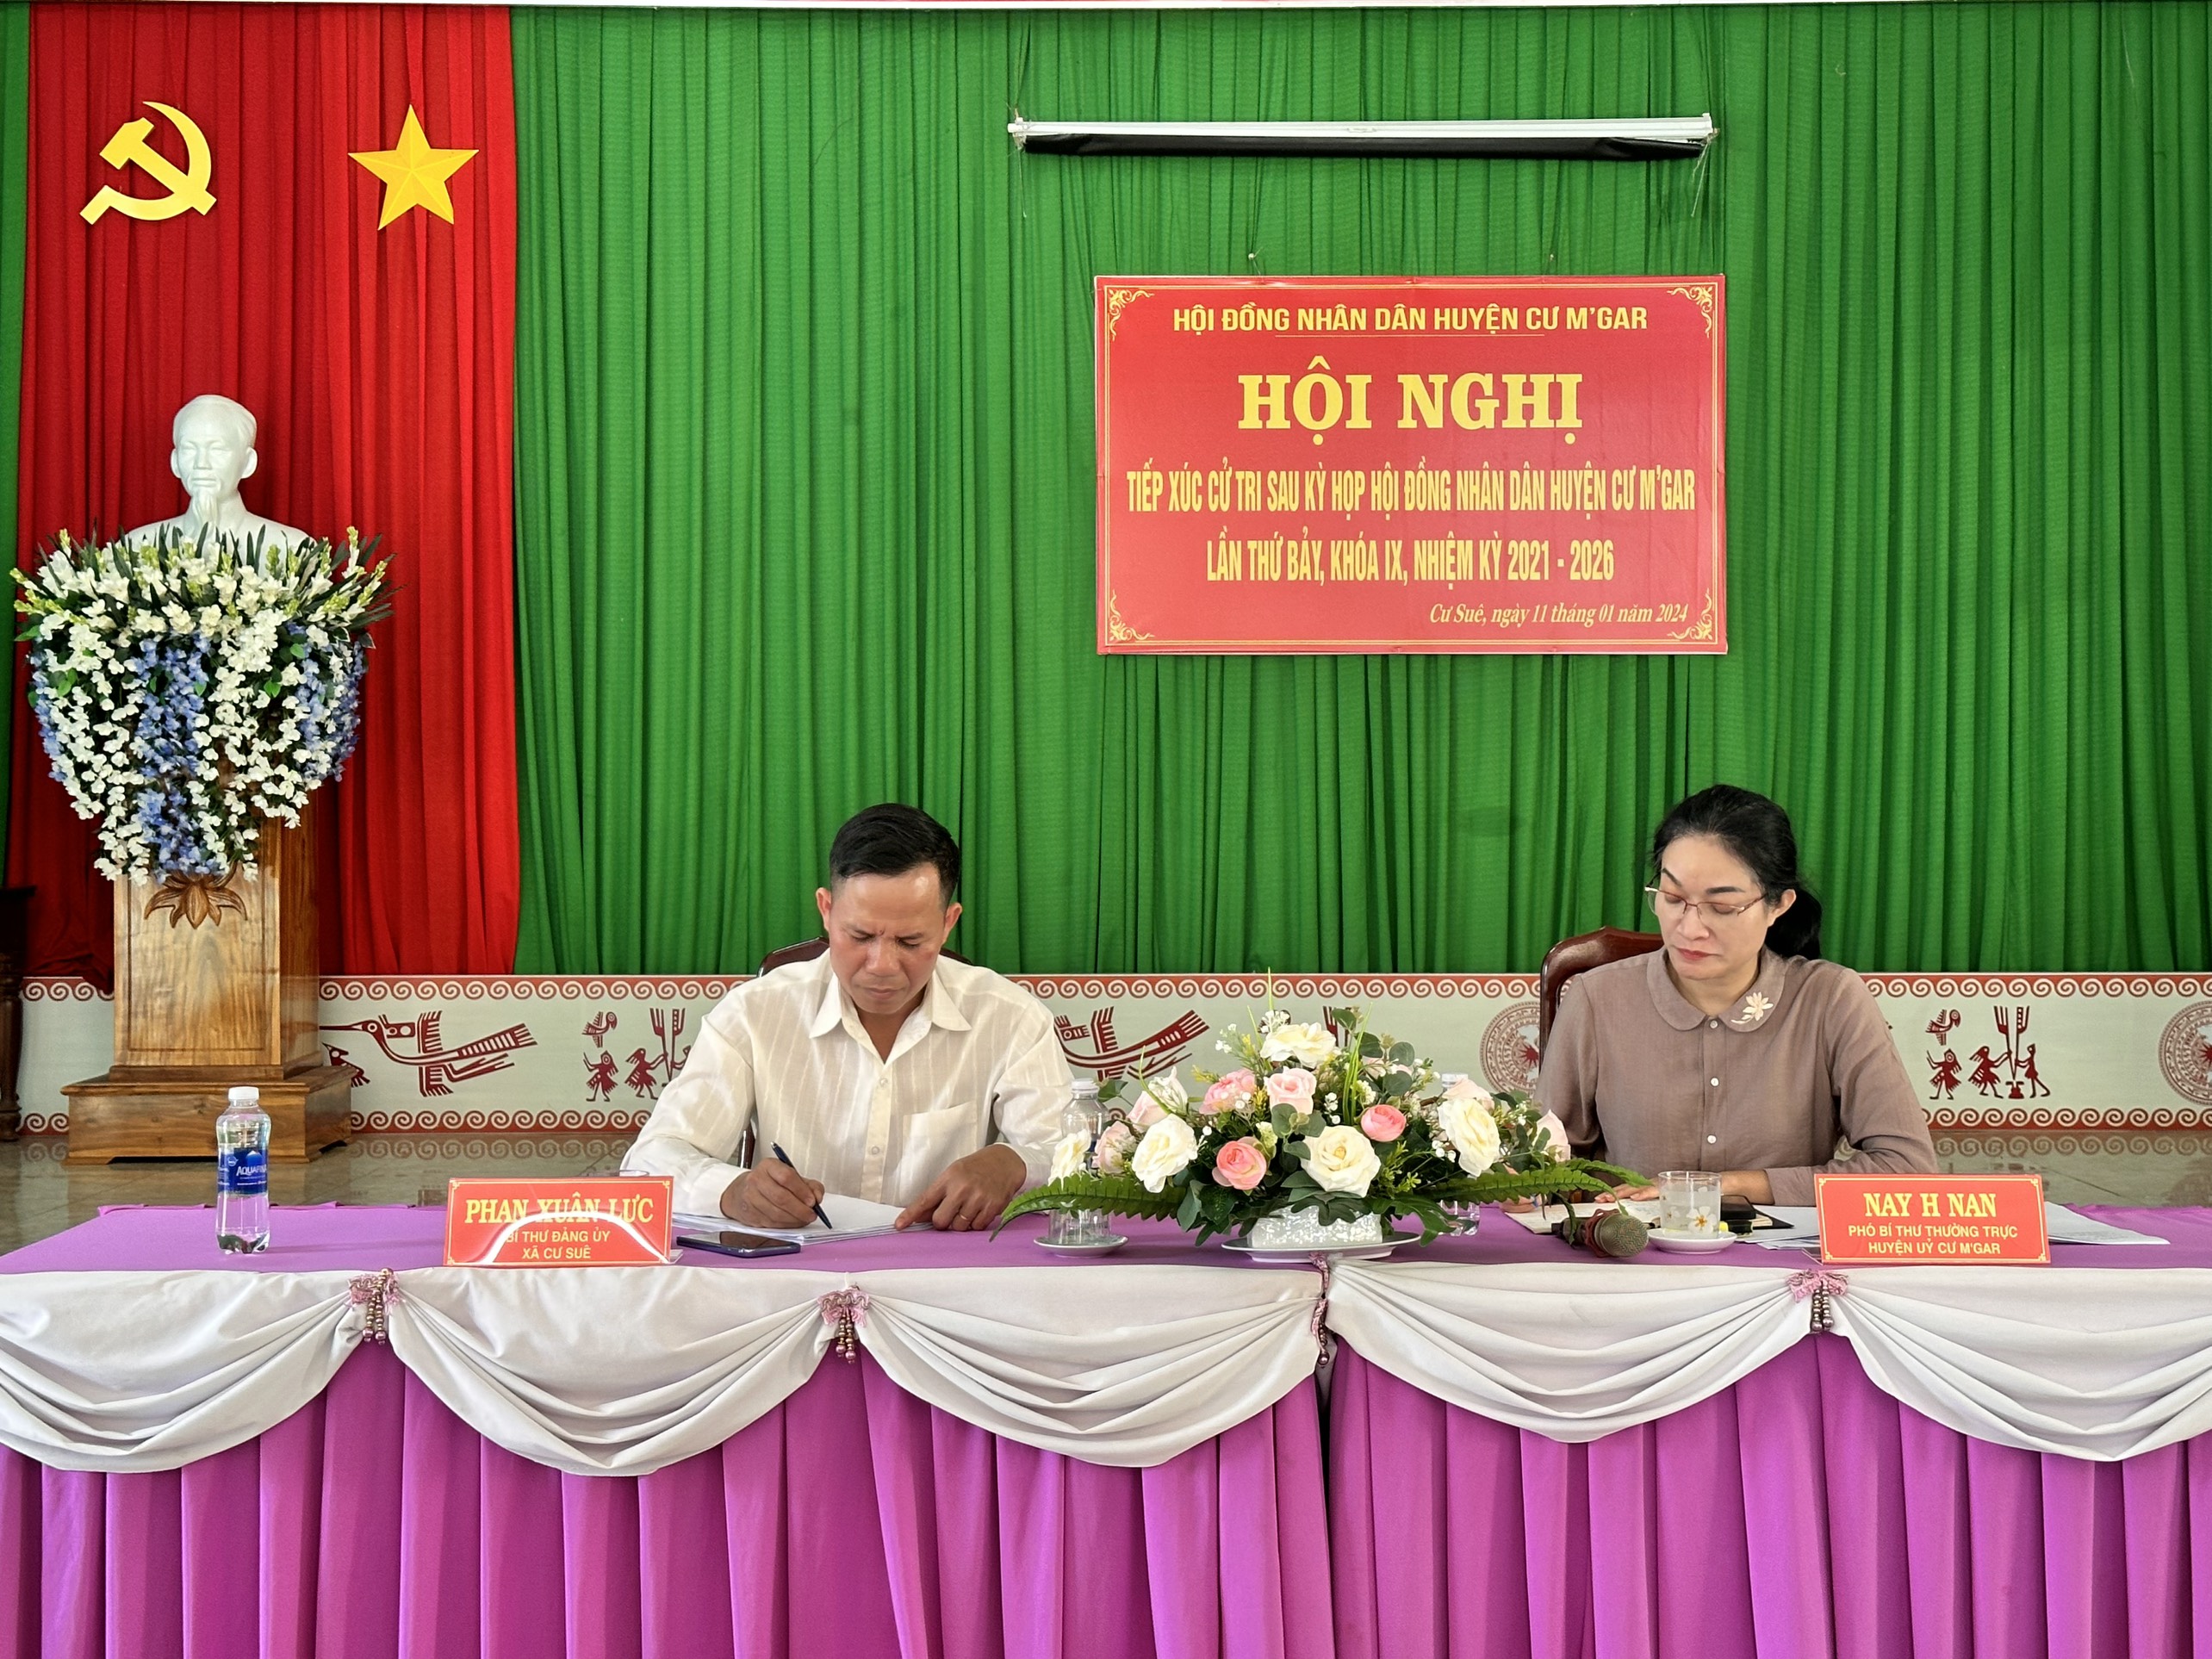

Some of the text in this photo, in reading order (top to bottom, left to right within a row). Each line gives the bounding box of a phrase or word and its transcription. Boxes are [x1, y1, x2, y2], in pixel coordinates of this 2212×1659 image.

[1173, 304, 1215, 332] HỘI
[1221, 301, 1289, 331] ĐỒNG
[1298, 303, 1367, 331] NHÂN
[1376, 303, 1426, 330] DÂN
[1434, 302, 1519, 333] HUYỆN
[1525, 306, 1560, 330] CƯ
[1238, 355, 1583, 445] HỘI NGHỊ
[1127, 457, 1164, 512] TIẾP
[1168, 462, 1202, 512] XÚC
[1208, 457, 1233, 512] CỬ
[1235, 470, 1262, 511] TRI
[1266, 469, 1300, 511] SAU
[1304, 462, 1327, 511] KỲ
[1331, 469, 1366, 520] HỌP
[1370, 461, 1399, 520] HỘI
[1404, 456, 1451, 511] ĐỒNG
[1456, 461, 1505, 511] NHÂN
[1509, 461, 1545, 511] DÂN
[1550, 460, 1606, 520] HUYỆN
[1611, 465, 1637, 510] CƯ
[1207, 525, 1614, 590] LẦN THỨ BẢY, KHÓA IX, NHIỆM KỲ 2021 - 2026
[1430, 602, 1689, 628] Cư Suê, ngày 11 tháng 01 năm 2024
[464, 1199, 529, 1224] PHAN
[535, 1191, 600, 1223] XUÂN
[1863, 1193, 1997, 1217] NAY H NAN
[522, 1229, 549, 1243] THƯ
[551, 1227, 588, 1242] ĐẢNG
[593, 1226, 611, 1242] ỦY
[1848, 1222, 2018, 1240] PHÓ BÍ THƯ THƯỜNG TRỰC
[522, 1245, 540, 1259] XÃ
[544, 1246, 562, 1259] CƯ
[1868, 1238, 2001, 1256] HUYỆN UỶ CƯ M'GAR
